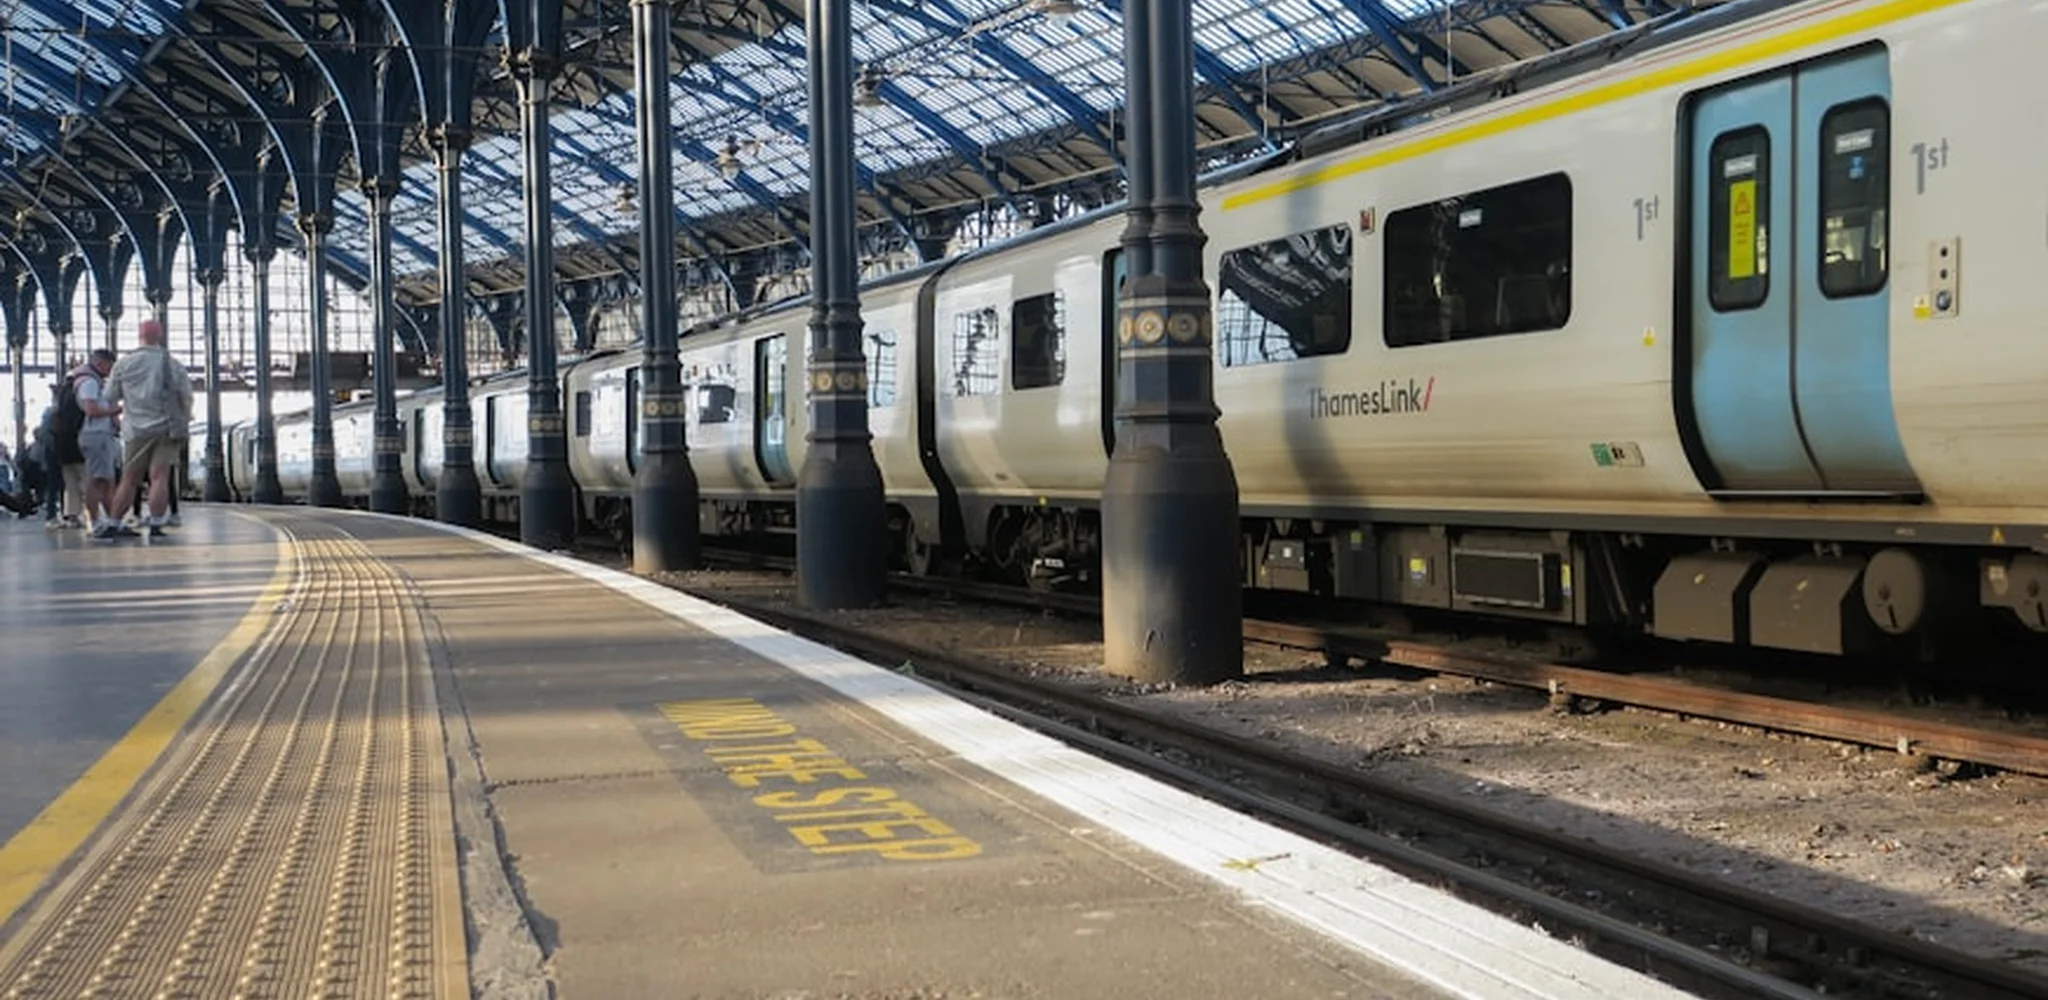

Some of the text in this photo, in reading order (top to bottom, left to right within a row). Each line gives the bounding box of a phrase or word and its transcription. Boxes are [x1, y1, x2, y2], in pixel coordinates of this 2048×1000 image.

[1910, 137, 1949, 195] 1st
[1633, 194, 1660, 241] 1st
[657, 698, 982, 860] MIND THE STEP
